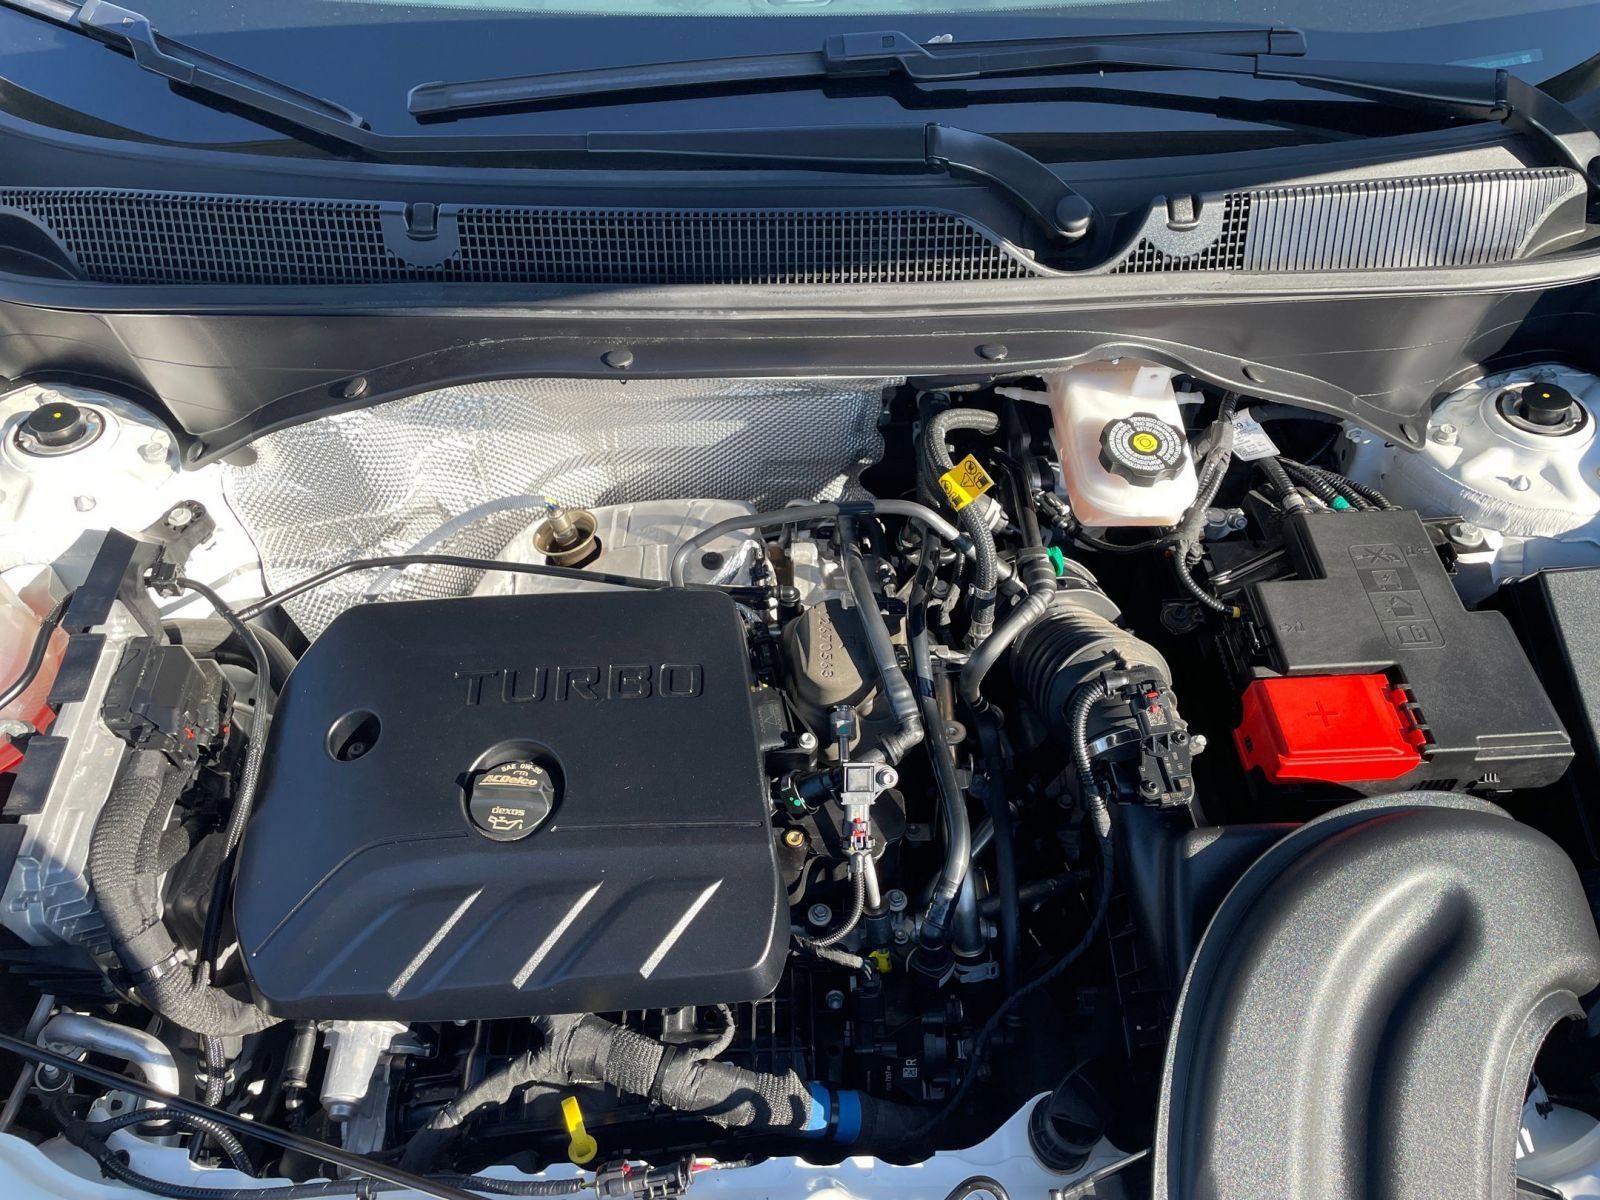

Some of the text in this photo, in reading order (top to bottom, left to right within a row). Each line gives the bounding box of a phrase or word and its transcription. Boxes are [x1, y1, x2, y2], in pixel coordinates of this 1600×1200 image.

[818, 610, 834, 678] 2670563
[454, 663, 704, 705] TURBO
[501, 763, 517, 772] SAE
[481, 774, 538, 786] ACDelco
[491, 806, 526, 816] dexos
[905, 1058, 918, 1066] R
